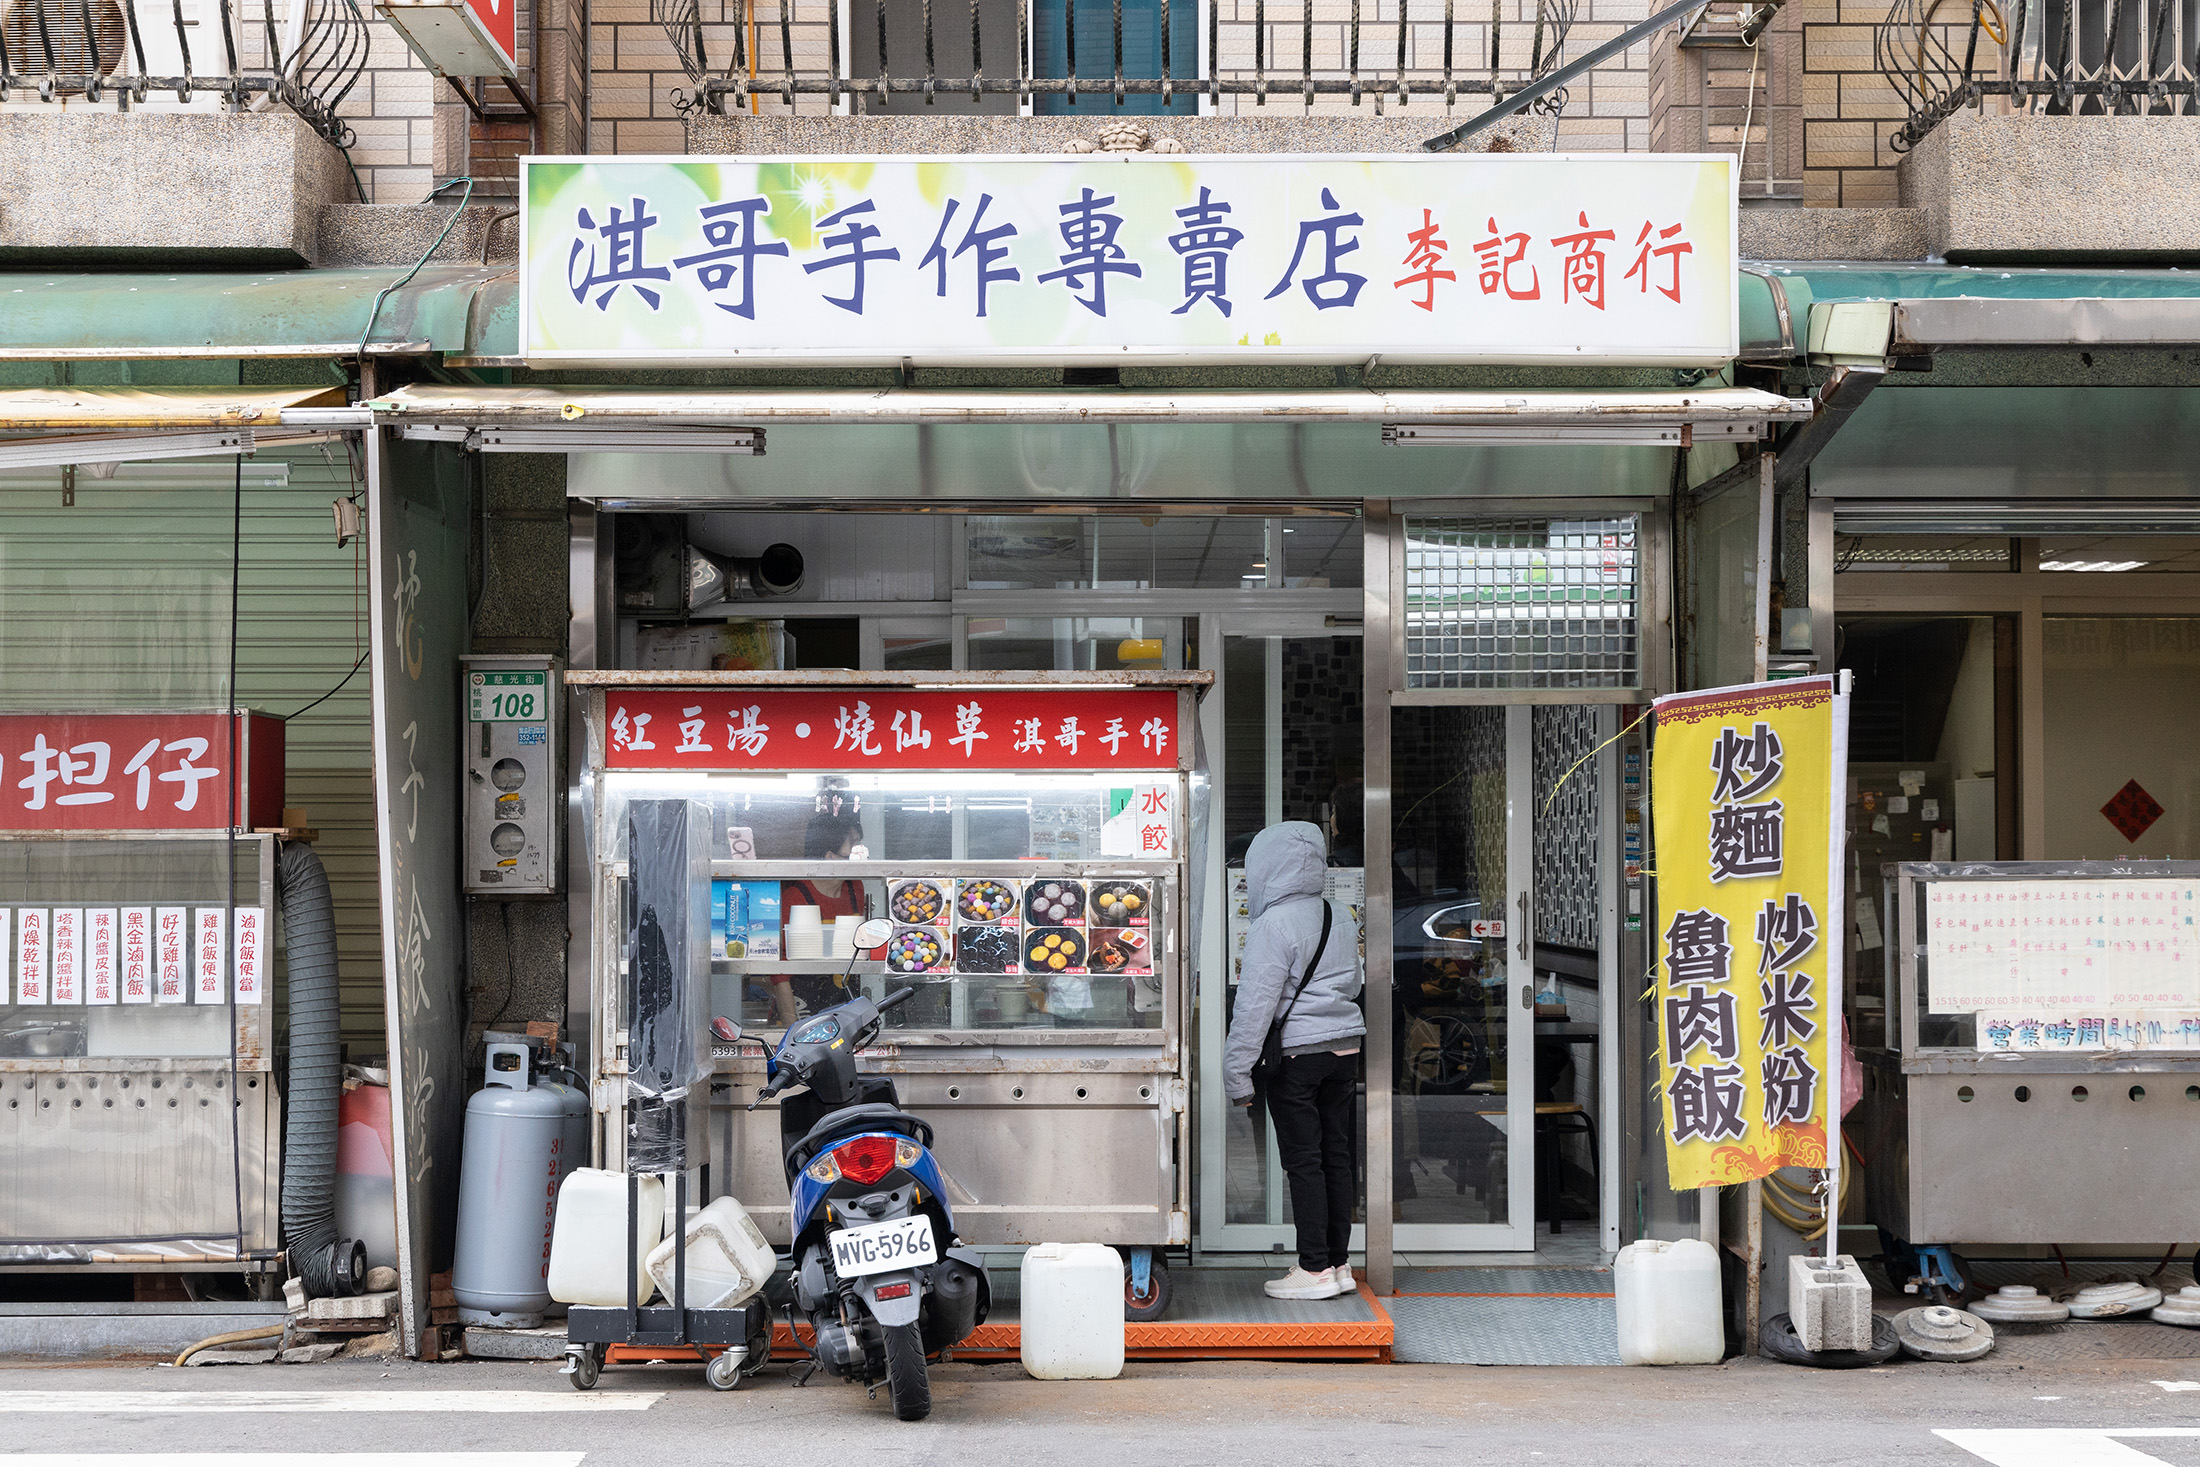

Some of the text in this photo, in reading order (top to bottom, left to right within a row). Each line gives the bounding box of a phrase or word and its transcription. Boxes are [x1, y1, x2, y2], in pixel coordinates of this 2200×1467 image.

[568, 186, 1693, 320] 淇哥手作專賣店 李記商行
[494, 674, 535, 685] 慈光街
[473, 688, 482, 719] 桃園區
[492, 693, 535, 718] 108
[1013, 716, 1170, 756] 淇哥手作
[0, 733, 220, 811] 担仔
[1711, 723, 1784, 882] 炒麵
[1141, 787, 1168, 851] 水餃
[1492, 922, 1501, 931] 拉
[23, 913, 40, 998] 肉燥乾拌麵
[56, 913, 74, 1000] 塔香辣肉醬拌麵
[95, 913, 110, 999] 辣肉醬皮蛋飯
[127, 912, 144, 995] 黑金滷肉飯
[162, 913, 179, 995] 好吃雞肉飯
[202, 913, 218, 991] 雞肉飯便當
[239, 914, 256, 991] 滷肉飯便當
[1758, 894, 1818, 1127] 炒米粉
[1936, 997, 1947, 1005] 15
[1948, 997, 1958, 1005] 15
[1960, 997, 1970, 1005] 60
[1972, 997, 1983, 1005] 60
[1985, 997, 1995, 1005] 60
[1997, 997, 2008, 1005] 60
[2010, 996, 2020, 1004] 30
[2022, 996, 2033, 1004] 40
[2035, 996, 2045, 1004] 40
[2047, 996, 2058, 1004] 40
[2113, 994, 2125, 1002] 60
[2128, 994, 2139, 1002] 50
[2143, 994, 2154, 1002] 40
[2157, 994, 2168, 1002] 40
[2172, 994, 2183, 1002] 40
[1665, 910, 1747, 1141] 魯肉飯
[1986, 1018, 2105, 1048] 營業時間
[711, 1046, 736, 1056] 6393
[541, 1138, 559, 1279] 3265230
[836, 1228, 931, 1266] MVG-5966
